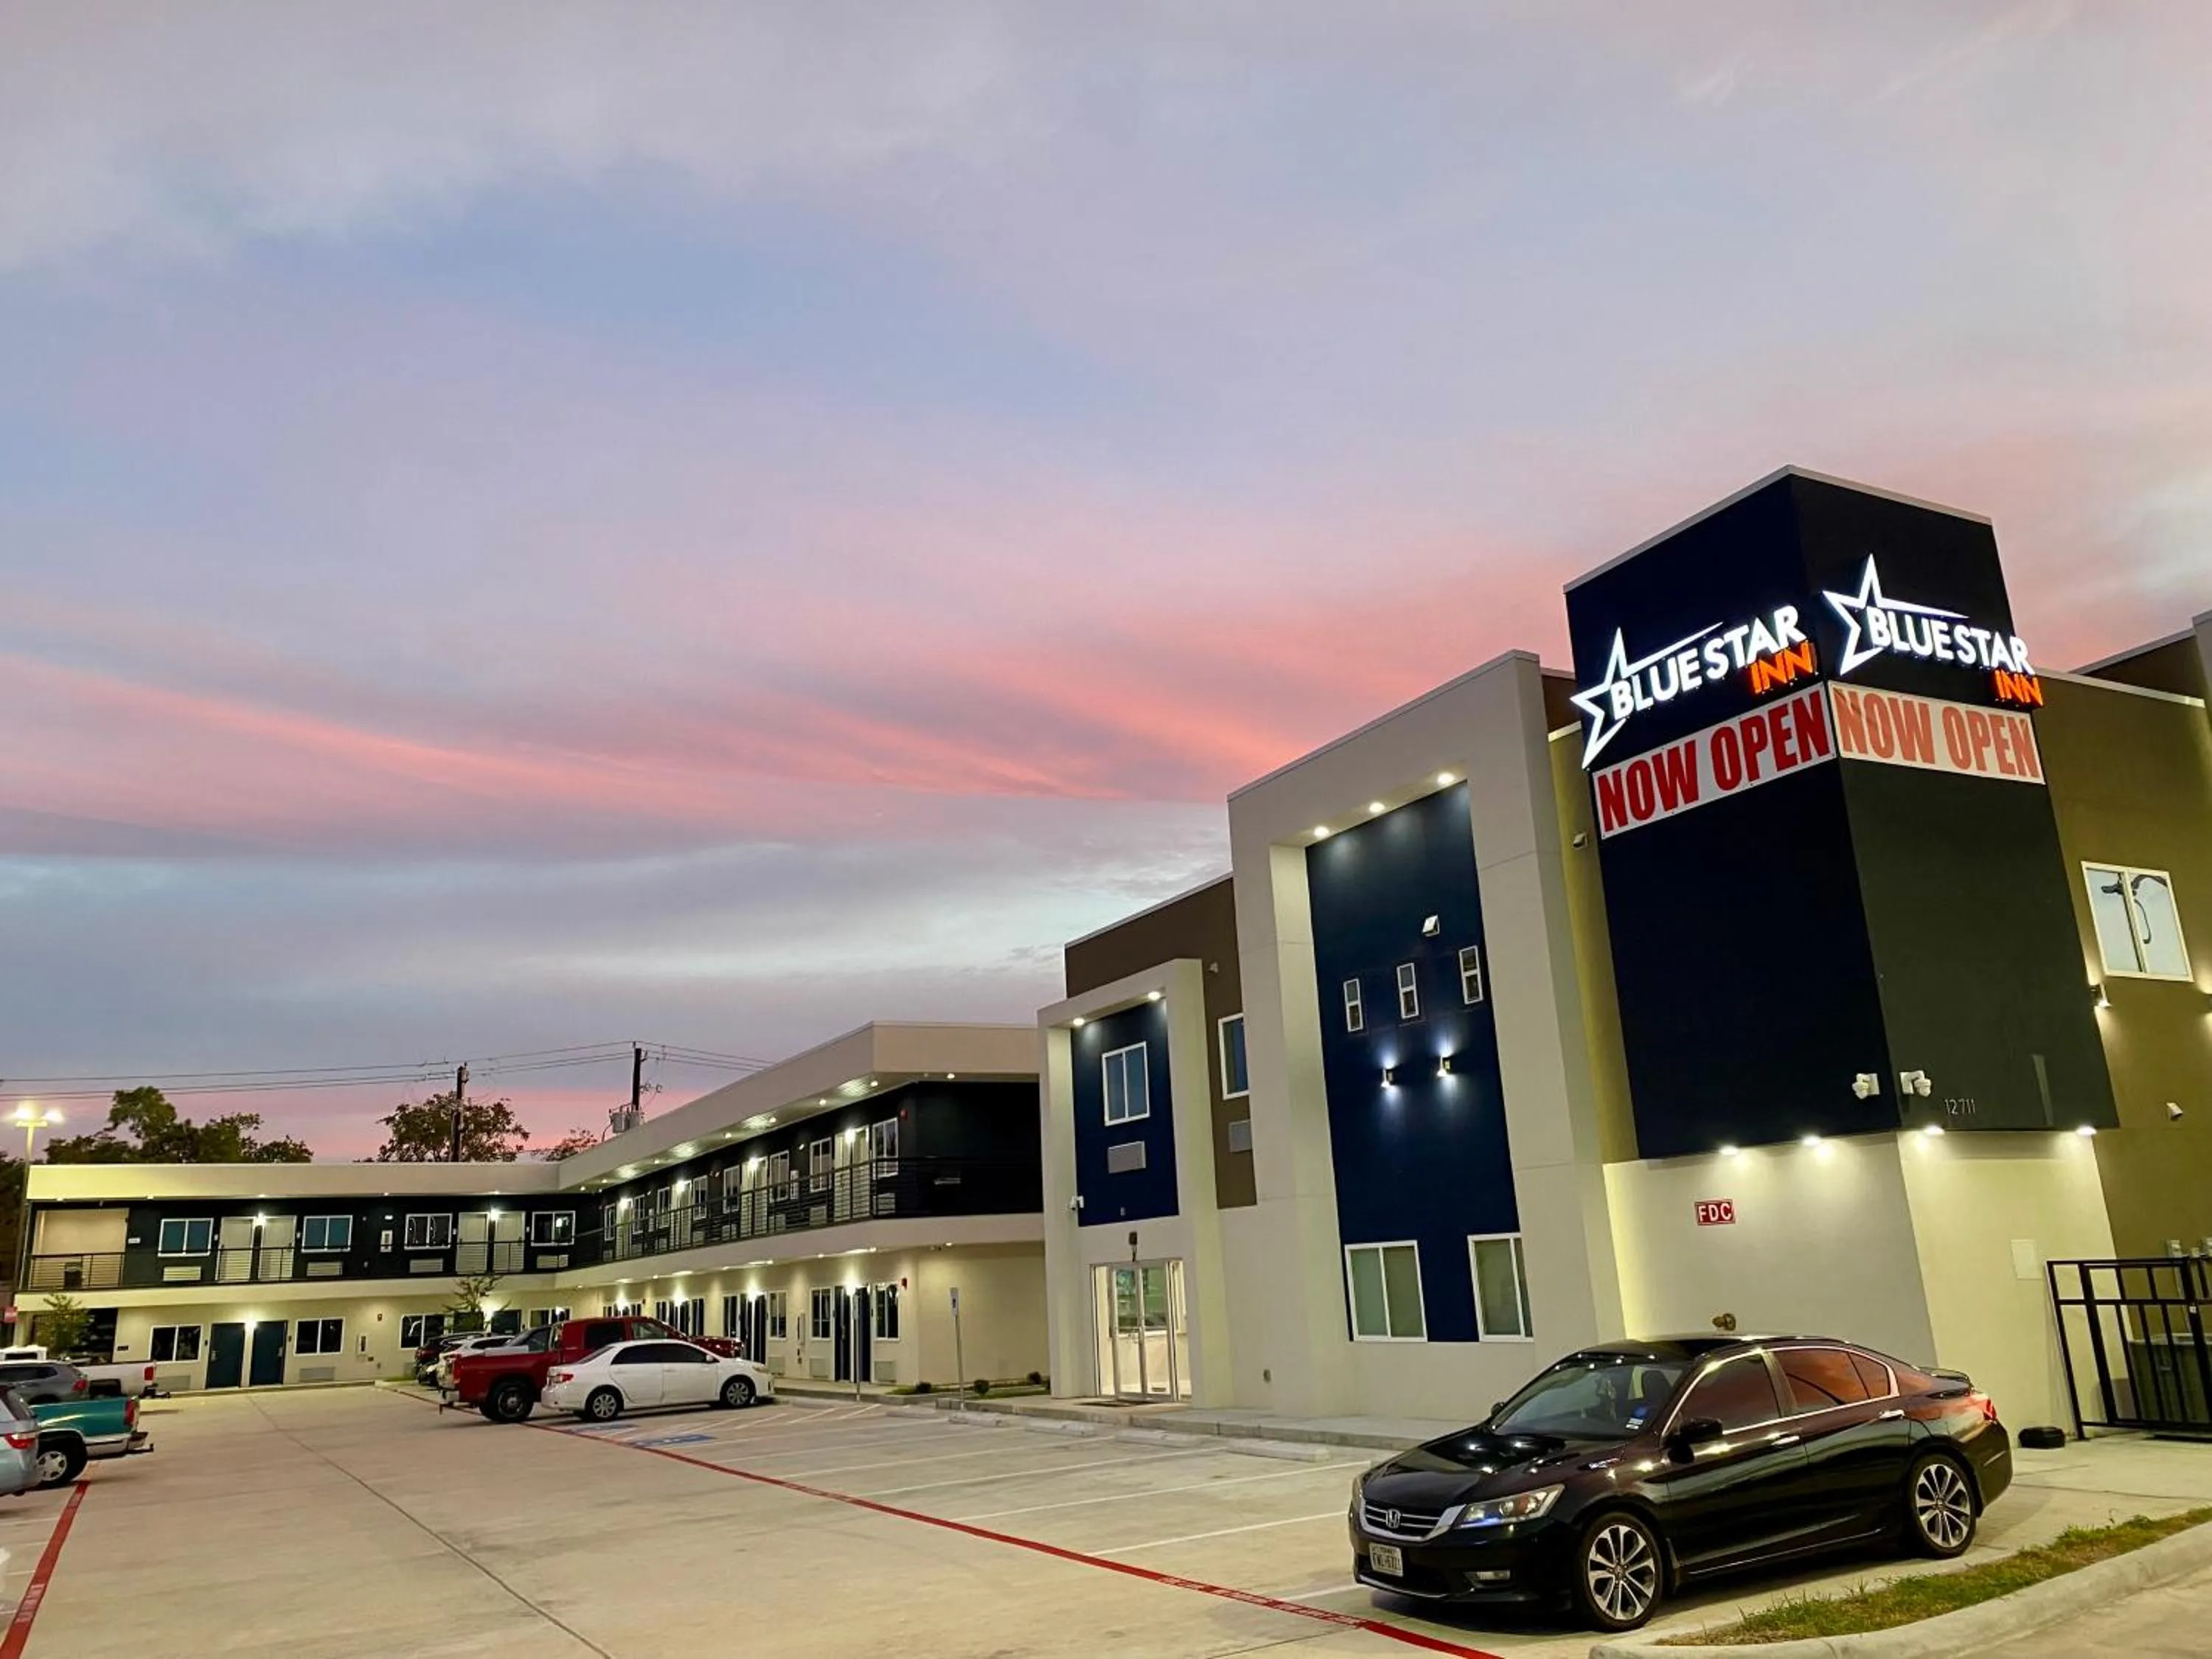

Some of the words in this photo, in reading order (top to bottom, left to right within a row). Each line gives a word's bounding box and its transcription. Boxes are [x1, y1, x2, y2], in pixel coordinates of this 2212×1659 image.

[1610, 648, 1703, 720] BLUE
[1704, 605, 1806, 679] STAR
[1749, 641, 1813, 694] INN
[1867, 606, 1954, 660] BLUE
[1954, 625, 2035, 675] STAR
[1994, 669, 2043, 706] INN
[1597, 740, 1700, 832] NOW
[1710, 690, 1830, 790] OPEN
[1833, 687, 1935, 764] NOW
[1942, 706, 2039, 779] OPEN
[1944, 1098, 1975, 1115] 12711
[1698, 1203, 1731, 1222] FDC
